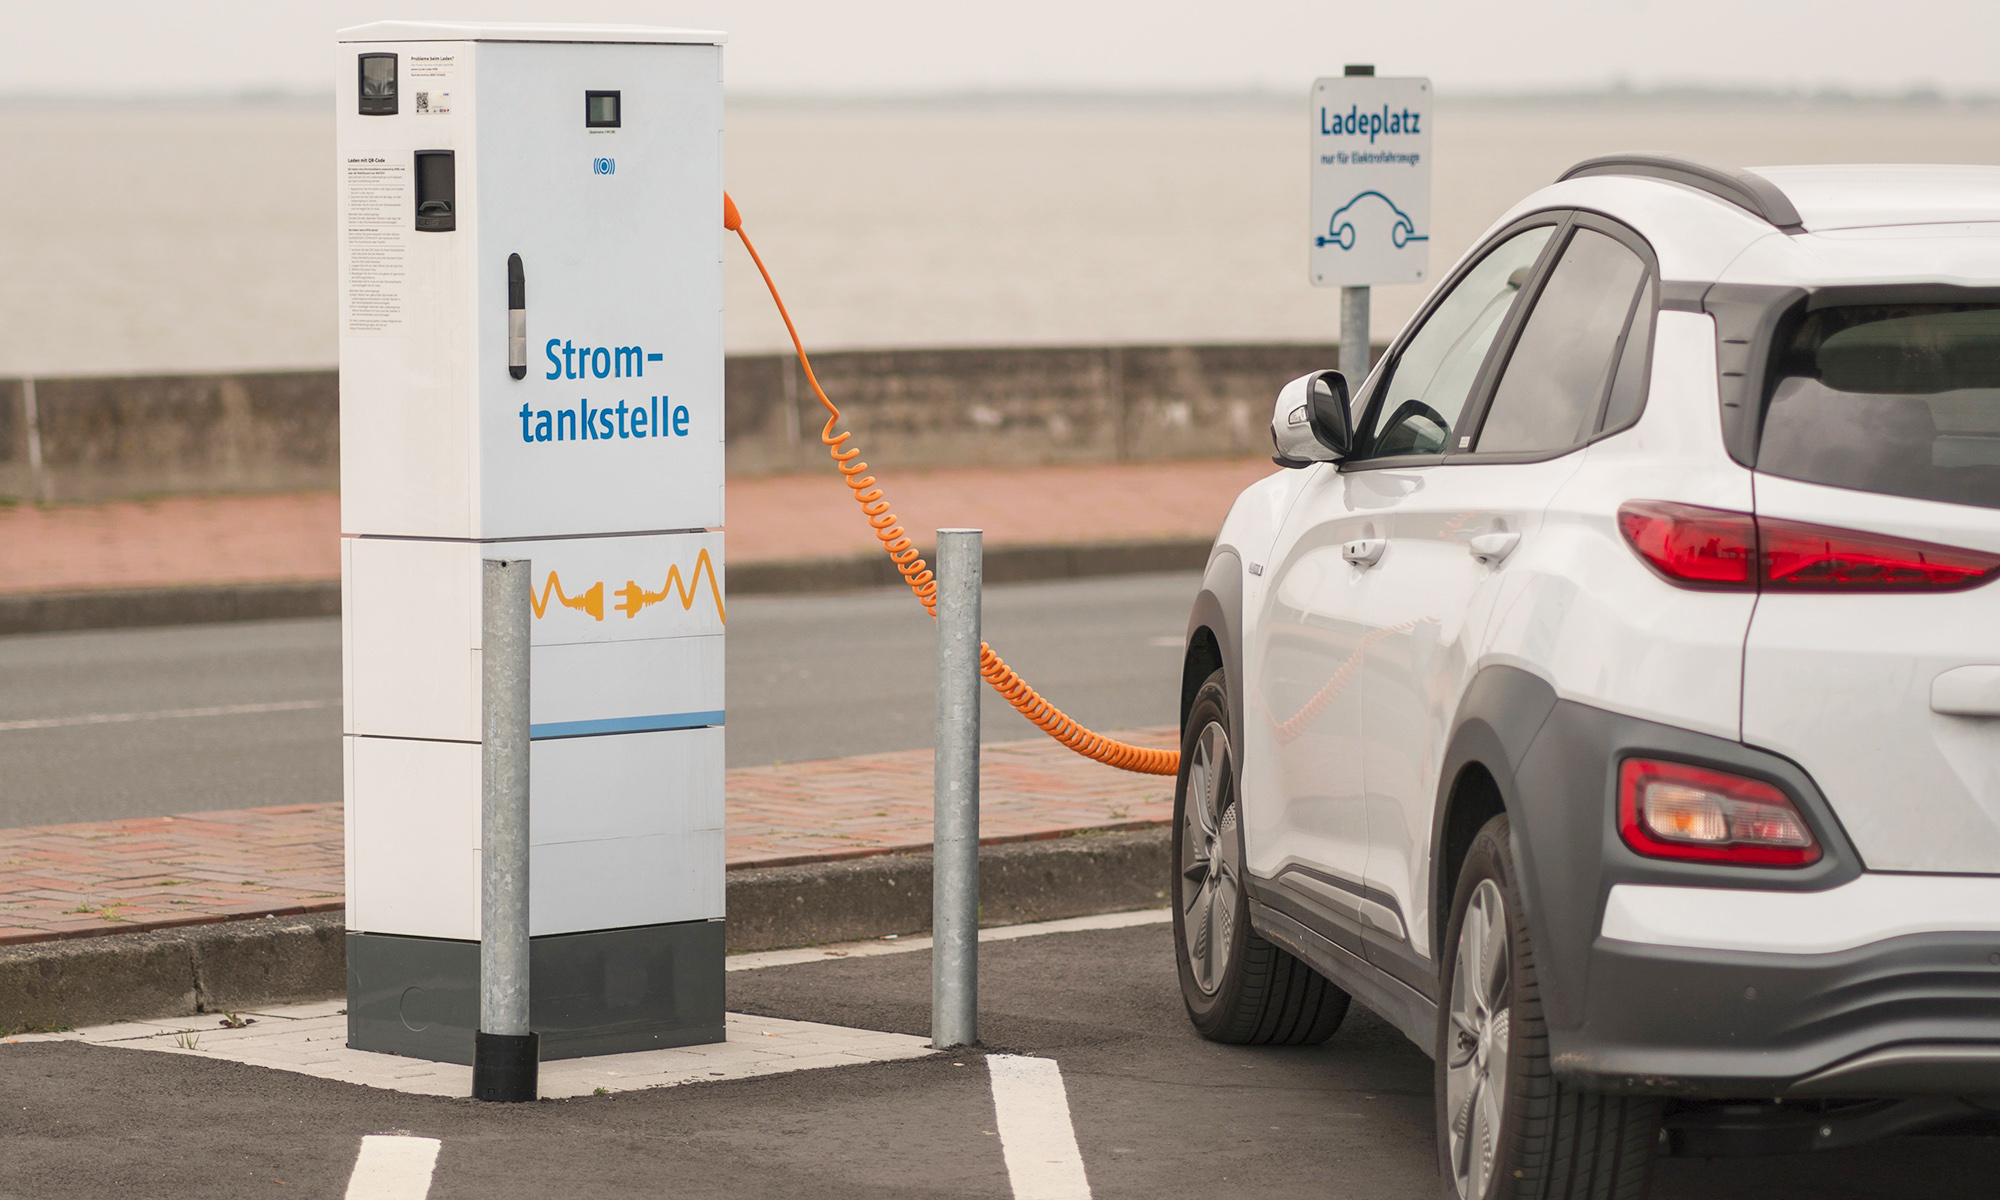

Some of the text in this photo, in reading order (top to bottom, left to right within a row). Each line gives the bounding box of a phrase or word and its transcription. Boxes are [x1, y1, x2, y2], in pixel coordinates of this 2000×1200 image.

[1321, 104, 1420, 144] Ladeplatz
[1321, 151, 1420, 167] nur für Elektrofahrzeuge
[545, 338, 663, 380] Strom-
[519, 395, 690, 443] tankstelle
